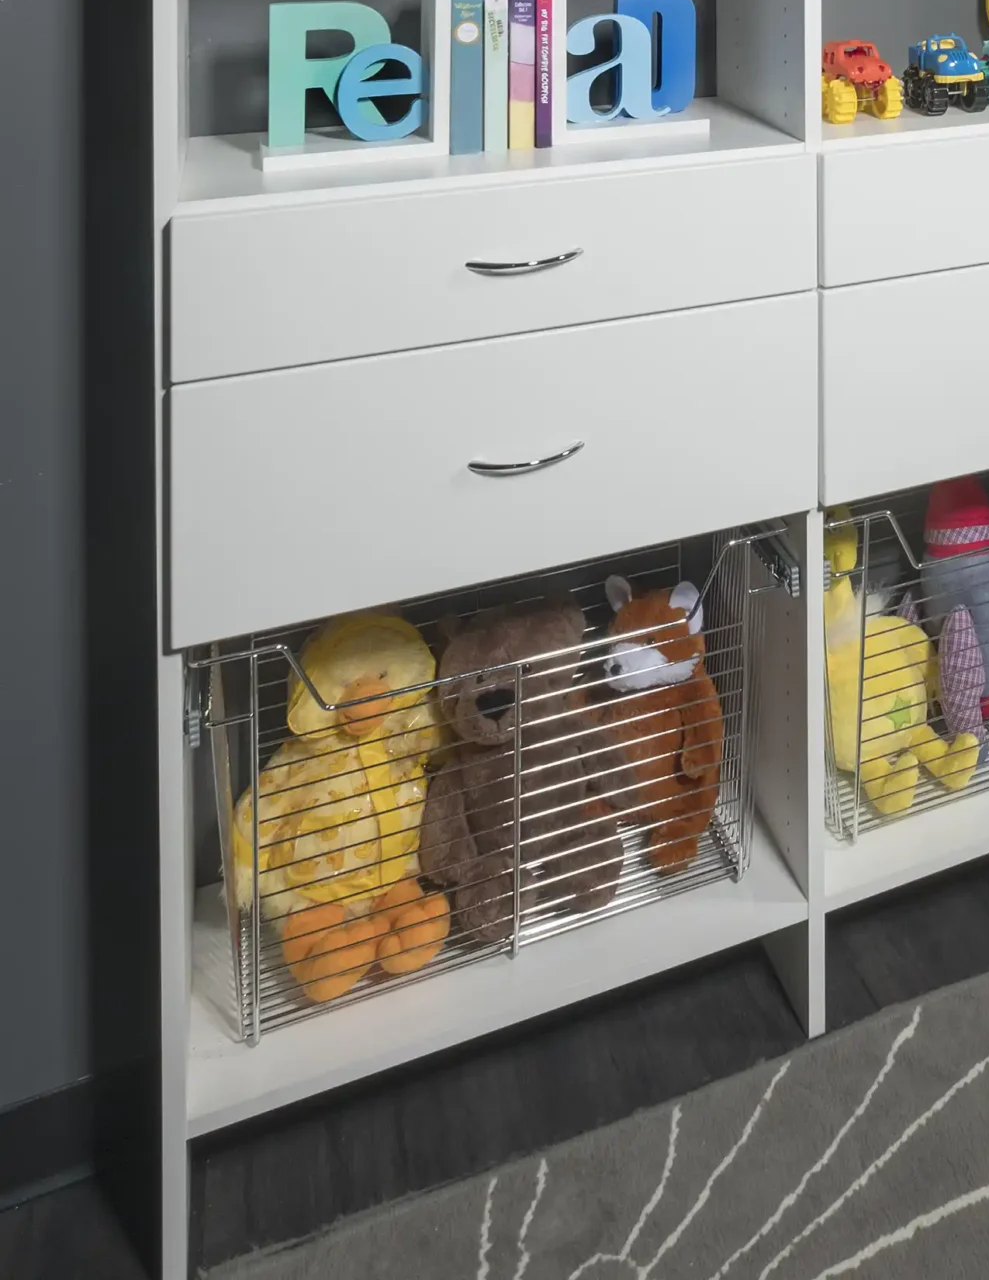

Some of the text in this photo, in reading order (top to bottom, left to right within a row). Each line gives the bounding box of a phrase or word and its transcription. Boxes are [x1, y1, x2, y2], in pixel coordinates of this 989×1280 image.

[541, 33, 549, 44] FAT
[541, 46, 549, 72] ZOMBIE
[541, 72, 549, 104] GOLDFISH
